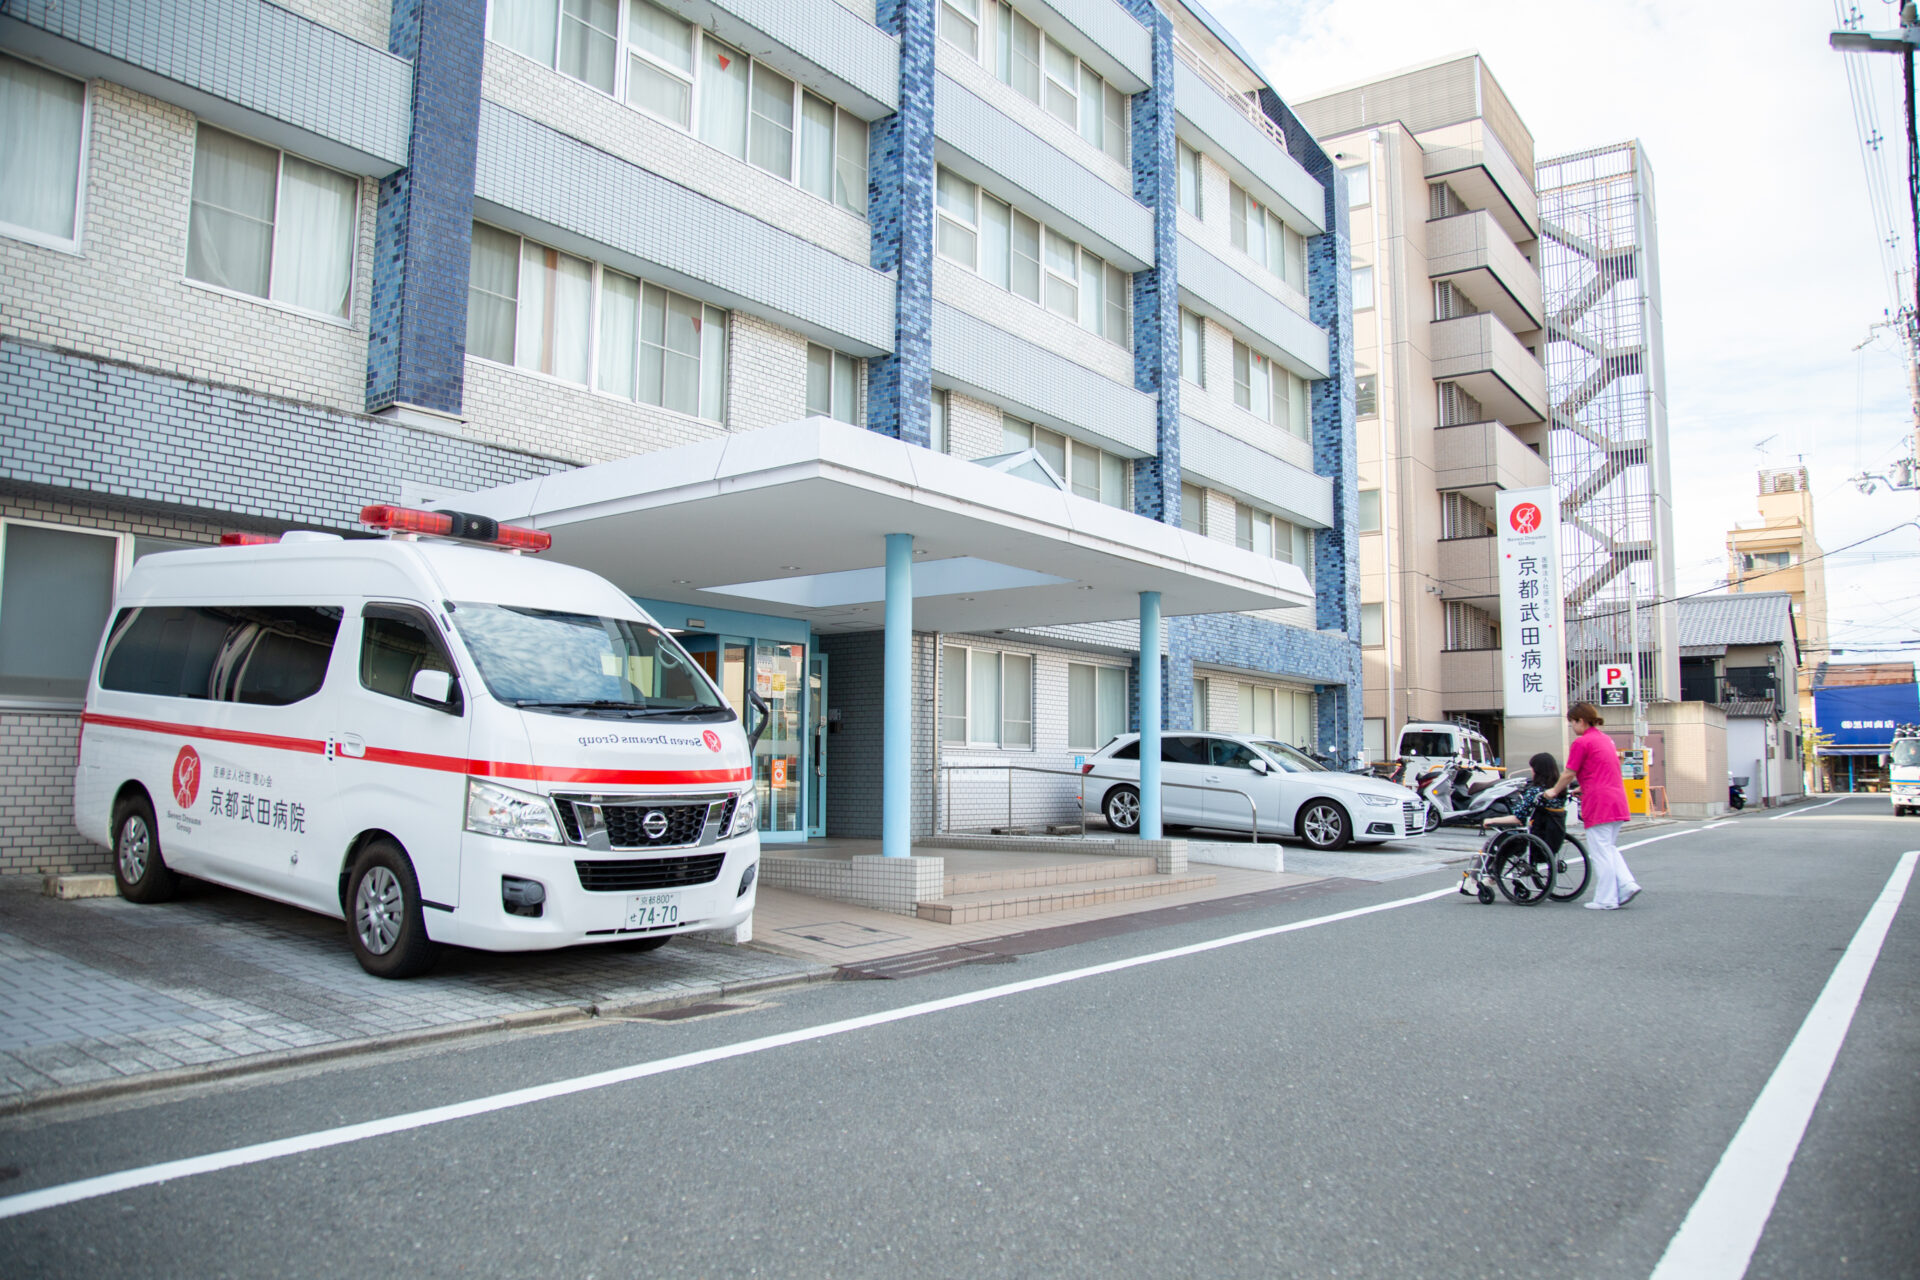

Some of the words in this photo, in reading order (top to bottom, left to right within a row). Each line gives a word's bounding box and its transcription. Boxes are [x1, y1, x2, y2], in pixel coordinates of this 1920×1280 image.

[1518, 555, 1543, 693] 京都武田病院
[1606, 668, 1621, 685] P
[1606, 689, 1623, 704] 空
[210, 786, 306, 834] 京都武田病院
[176, 822, 192, 835] Group
